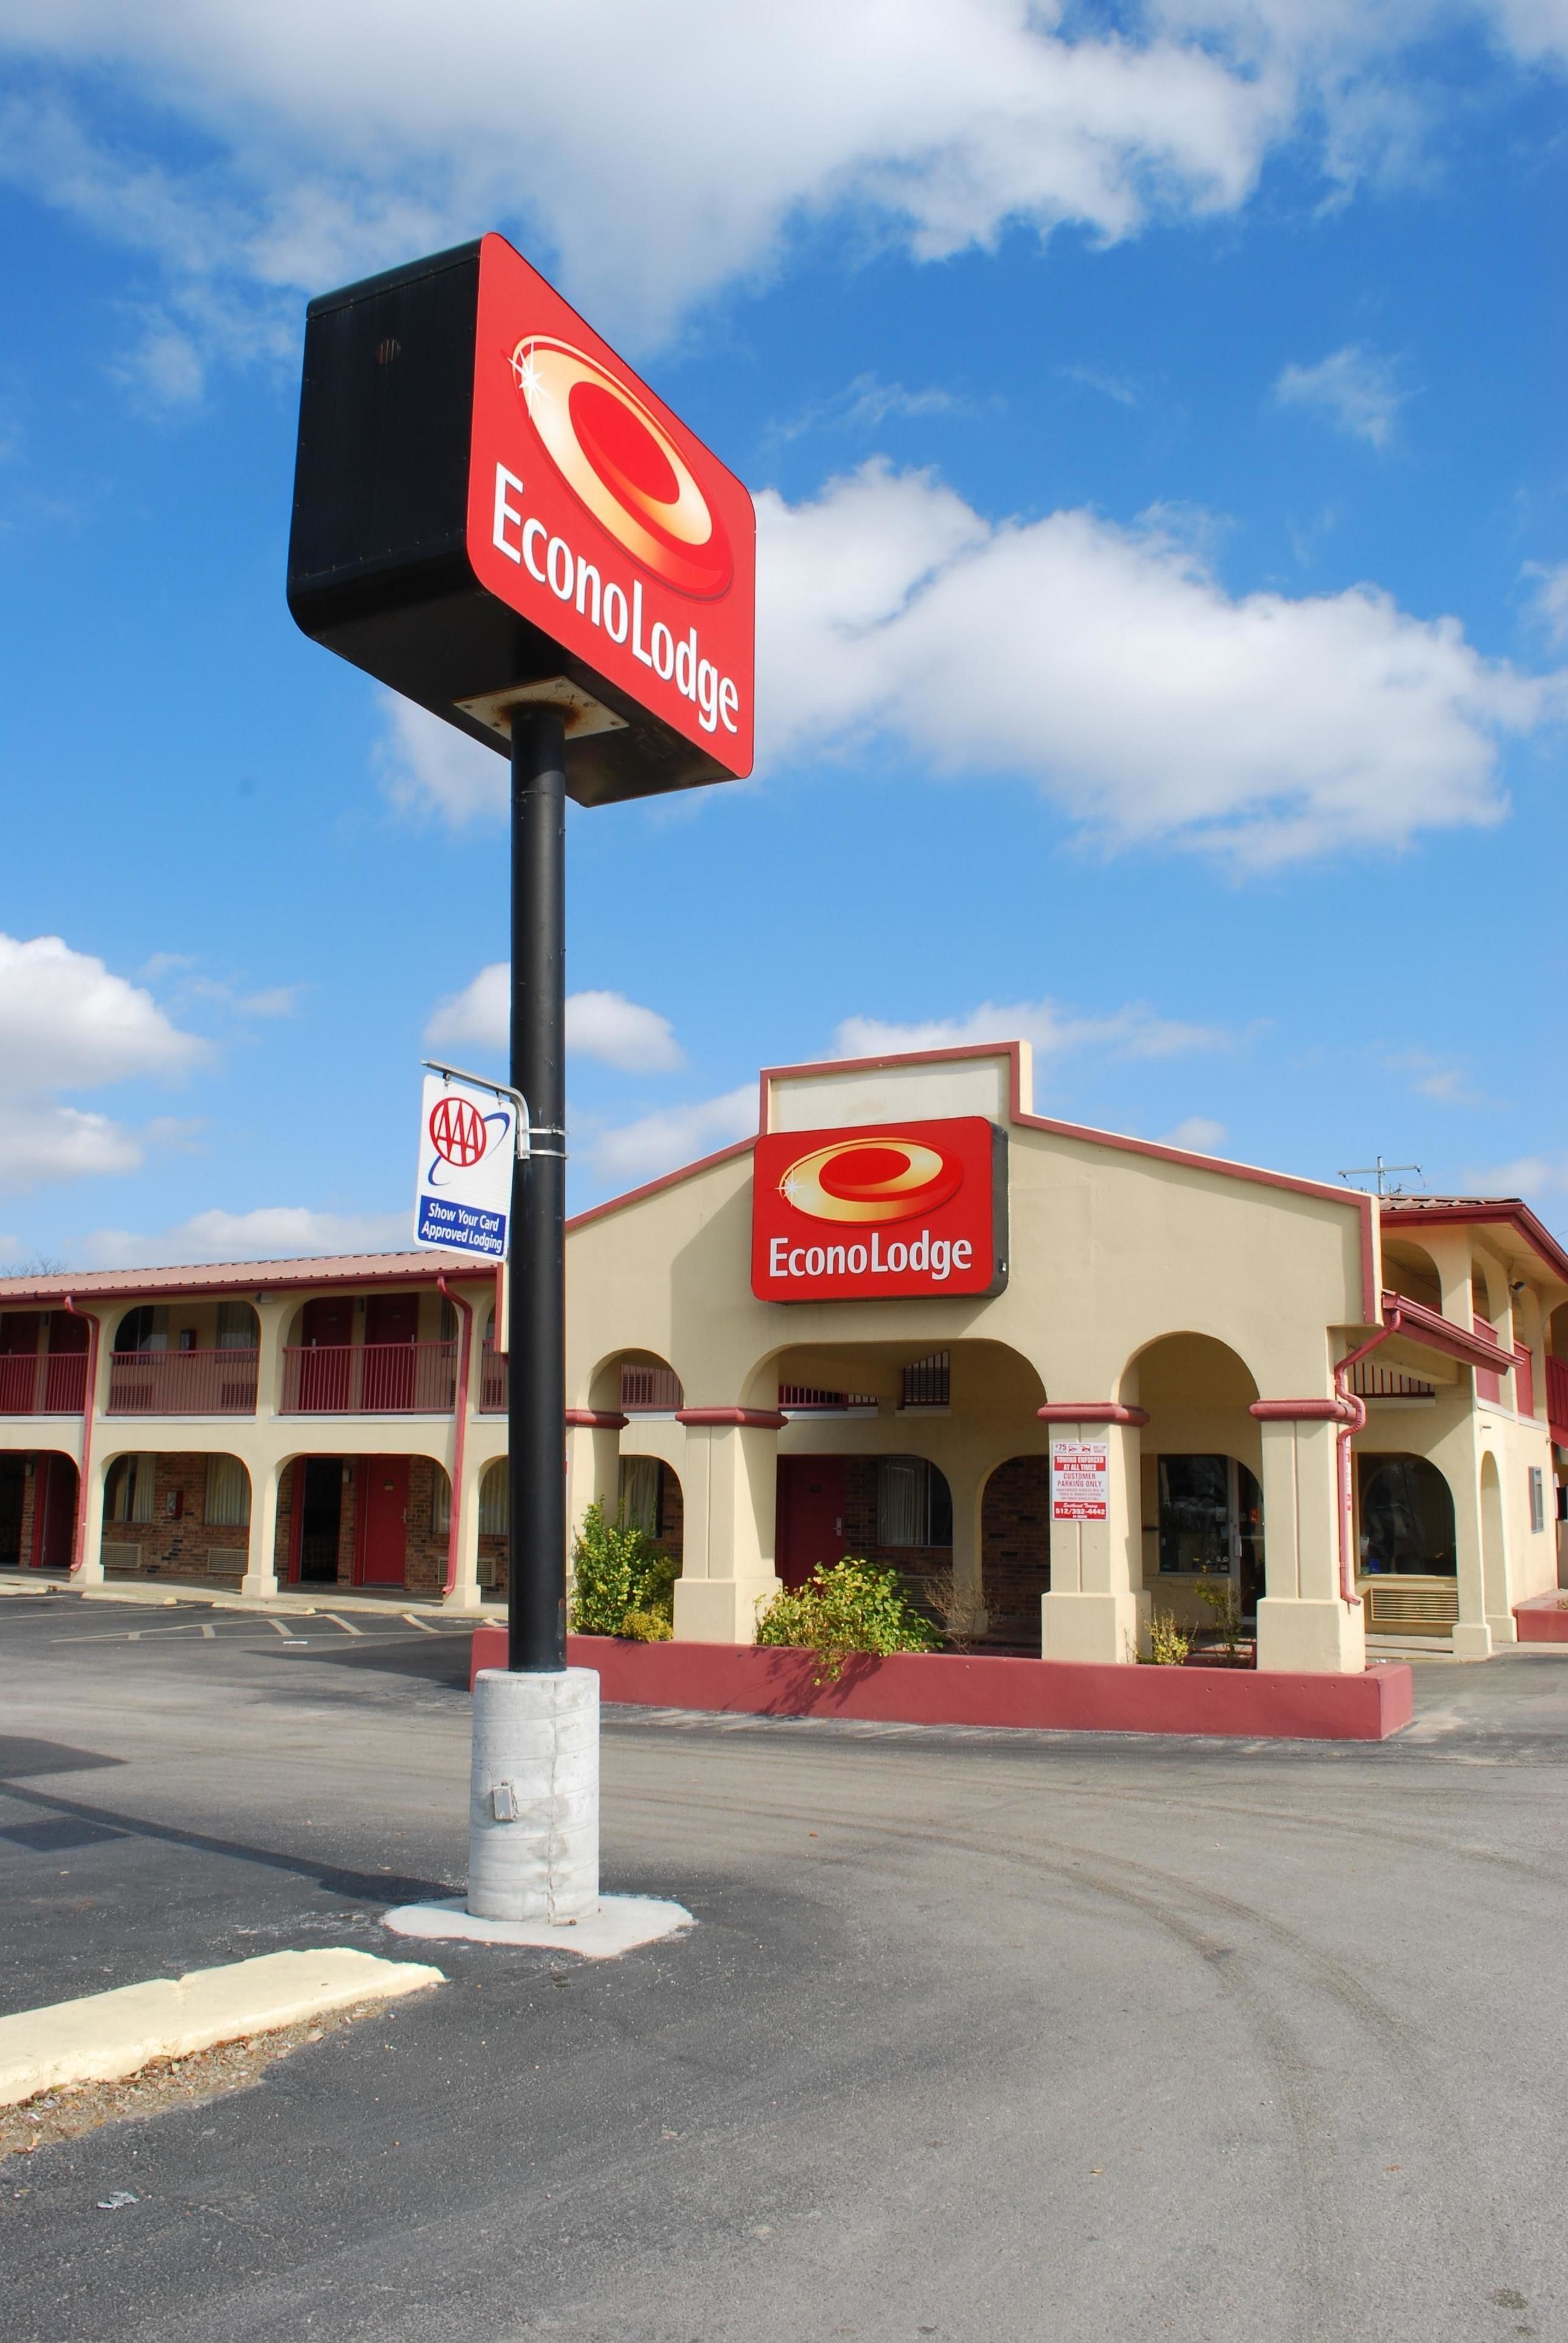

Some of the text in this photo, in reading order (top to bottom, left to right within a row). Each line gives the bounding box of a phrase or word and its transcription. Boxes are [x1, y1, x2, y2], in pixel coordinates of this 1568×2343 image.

[492, 461, 739, 734] EconoLodge
[433, 1098, 483, 1165] AAA
[422, 1220, 503, 1254] Approved Lodging
[428, 1202, 499, 1233] Show Your Card
[769, 1230, 973, 1280] EconoLodge
